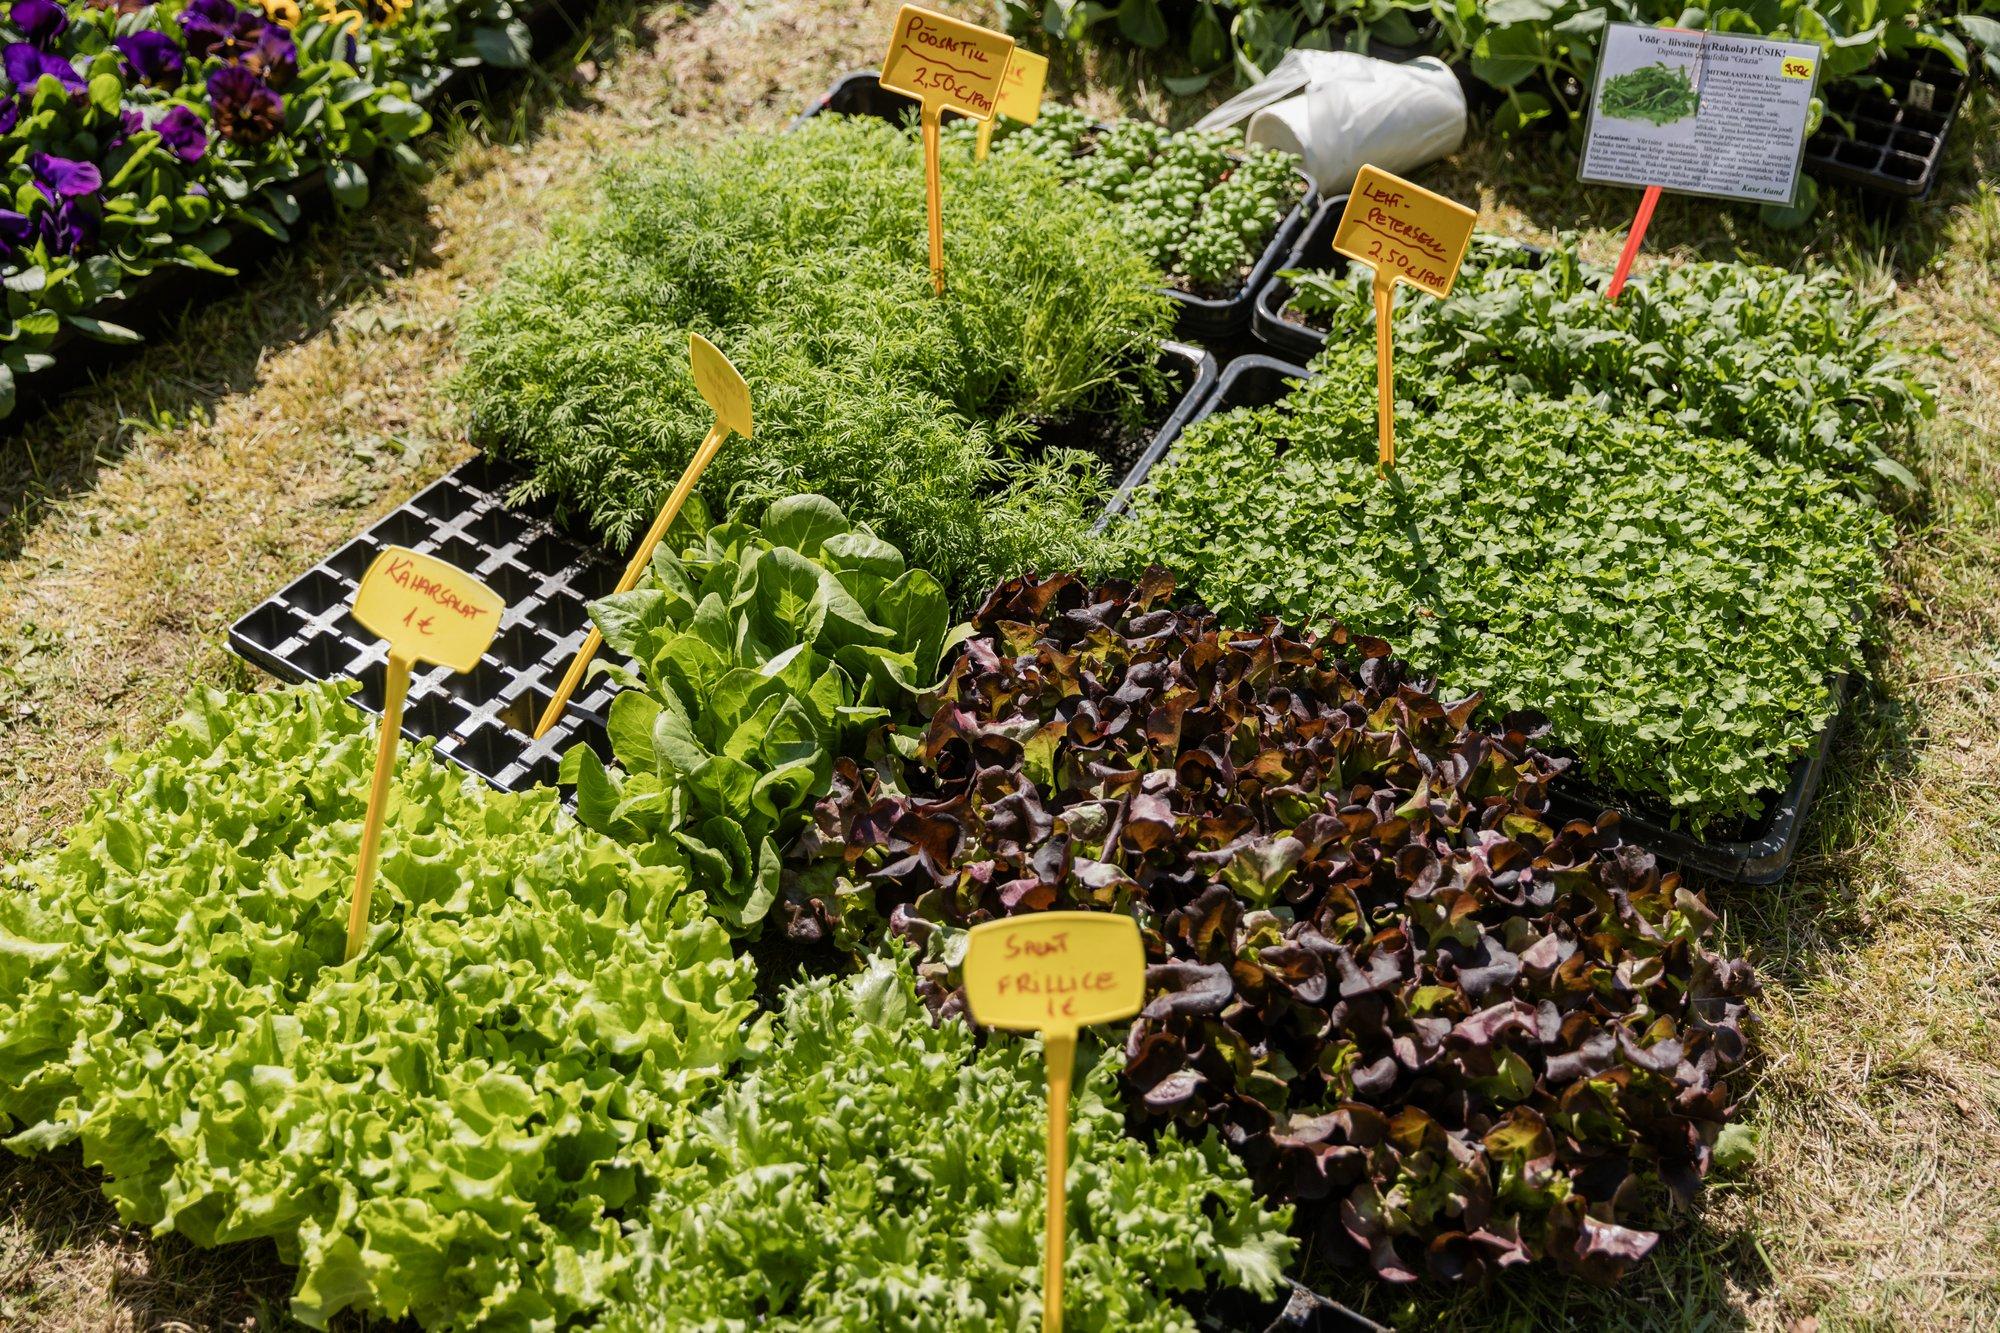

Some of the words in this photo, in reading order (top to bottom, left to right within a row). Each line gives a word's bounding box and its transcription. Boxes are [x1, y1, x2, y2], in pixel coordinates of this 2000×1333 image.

[1657, 48, 1694, 58] Diplotaxis
[1707, 42, 1748, 54] (Rukola)
[1750, 47, 1786, 58] PÜSIK!
[1706, 70, 1763, 80] MITMEAASTANE!
[1741, 185, 1760, 193] Kase
